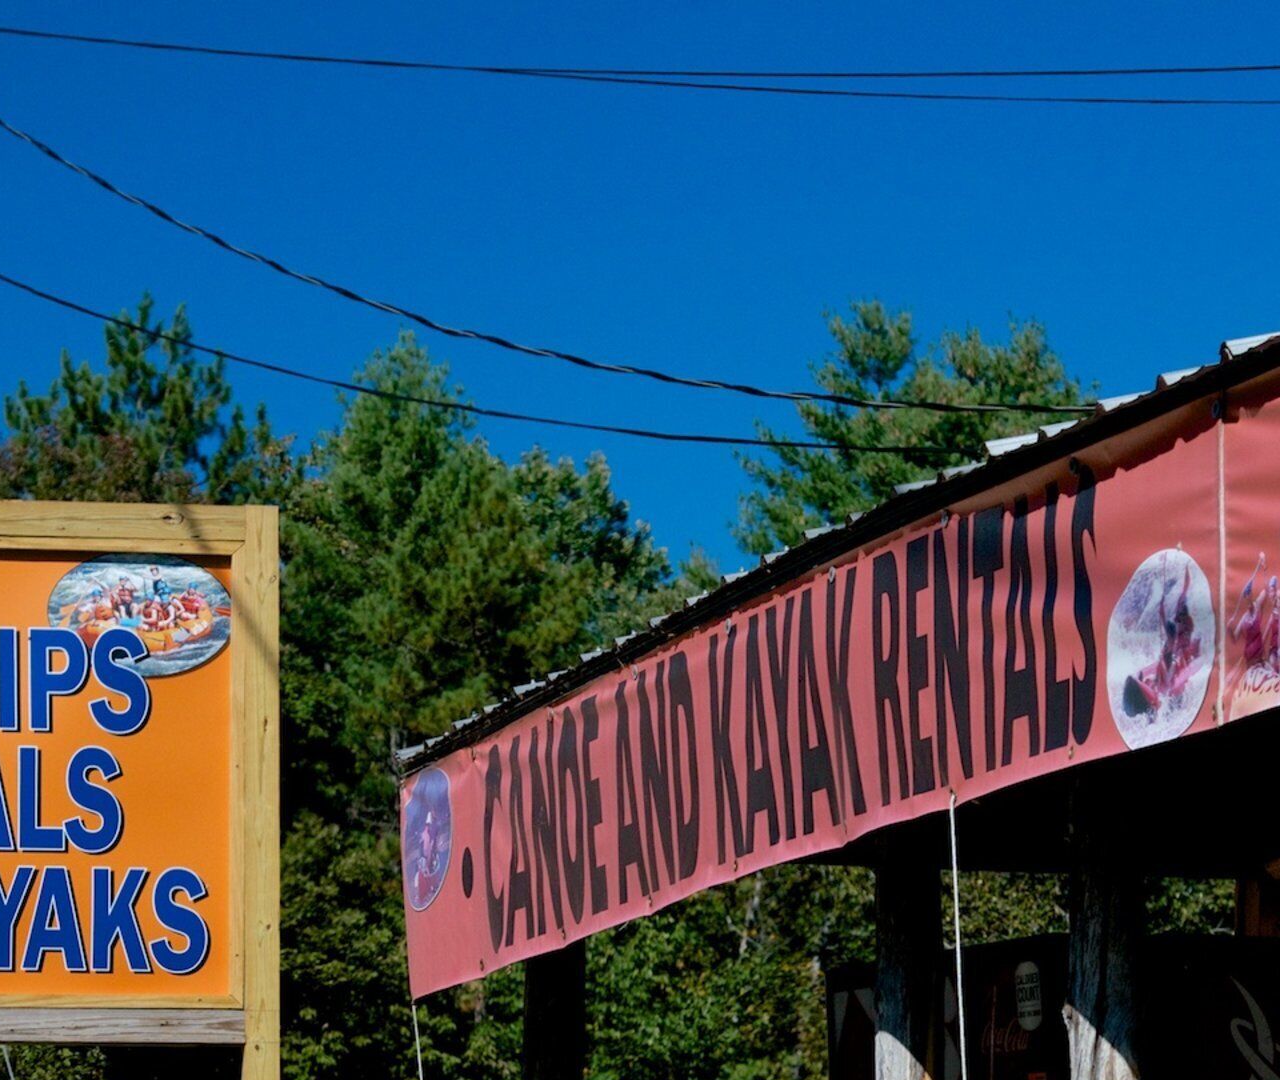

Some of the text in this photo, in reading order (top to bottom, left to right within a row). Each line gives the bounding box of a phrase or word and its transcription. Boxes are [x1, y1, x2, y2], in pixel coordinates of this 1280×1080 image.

[482, 466, 1098, 954] CANOE AND KAYAK RENTALS
